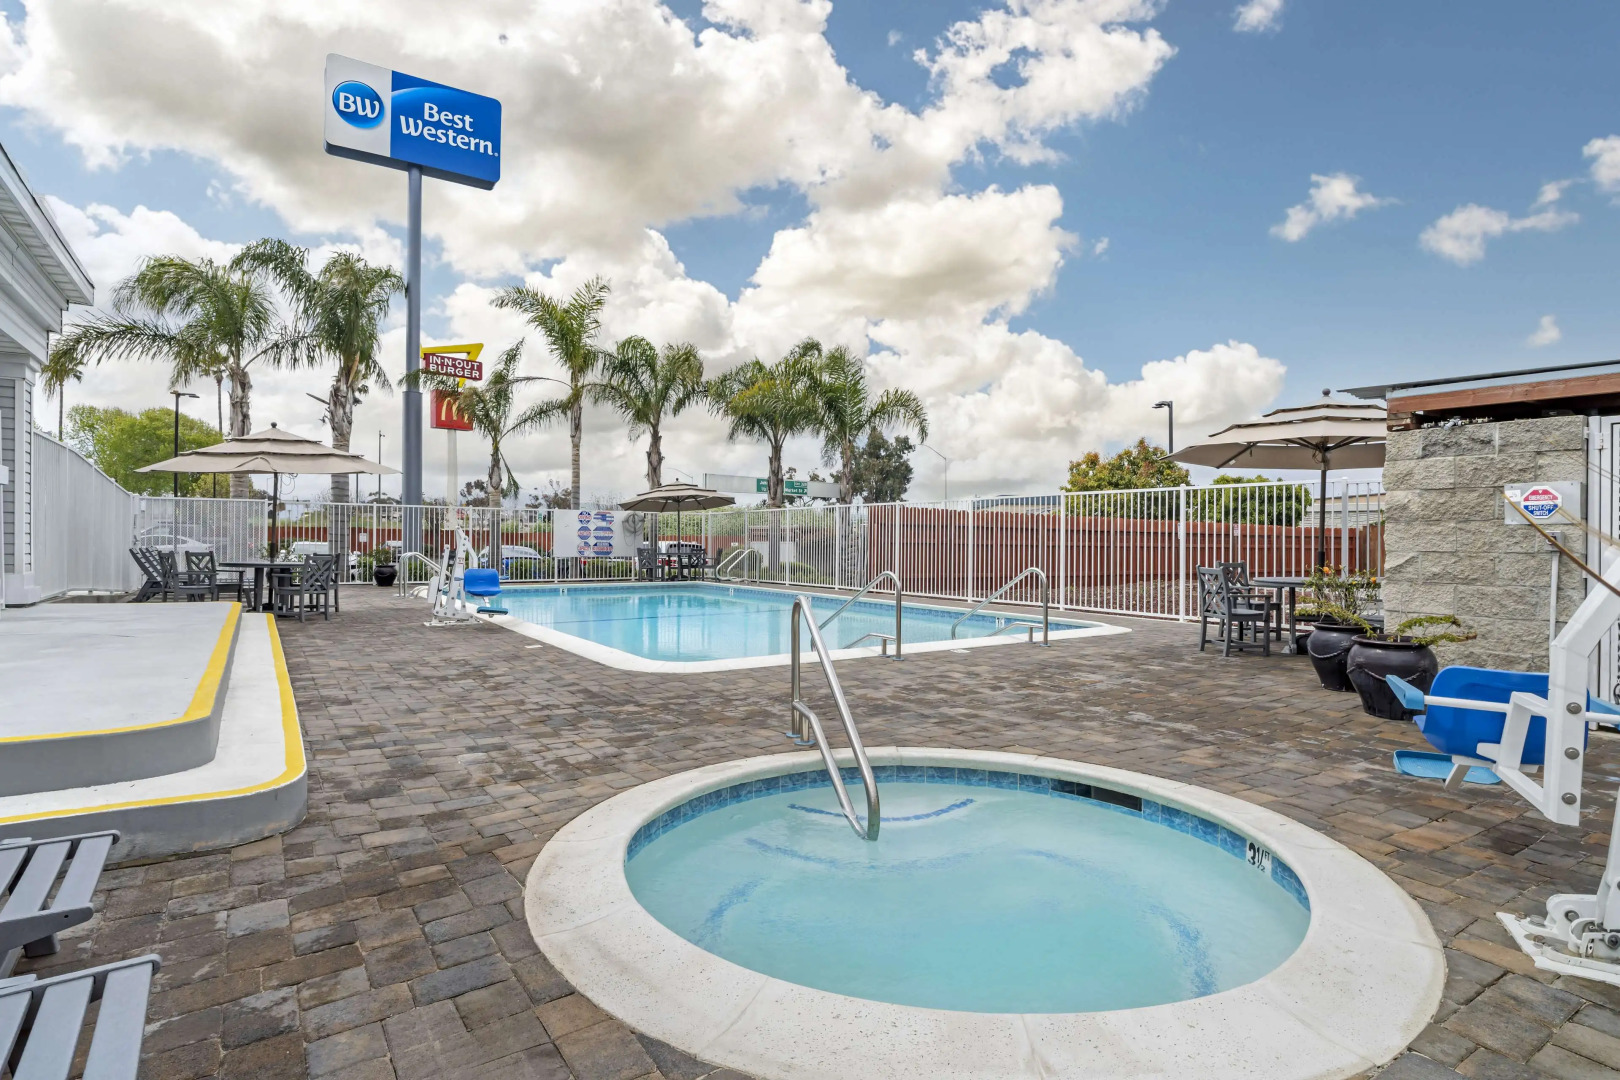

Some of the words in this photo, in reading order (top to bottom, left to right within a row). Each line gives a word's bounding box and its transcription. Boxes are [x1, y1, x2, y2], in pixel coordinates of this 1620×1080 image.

[339, 92, 380, 119] BW
[424, 102, 474, 132] Best
[400, 115, 495, 156] Western
[429, 363, 480, 379] BURGER
